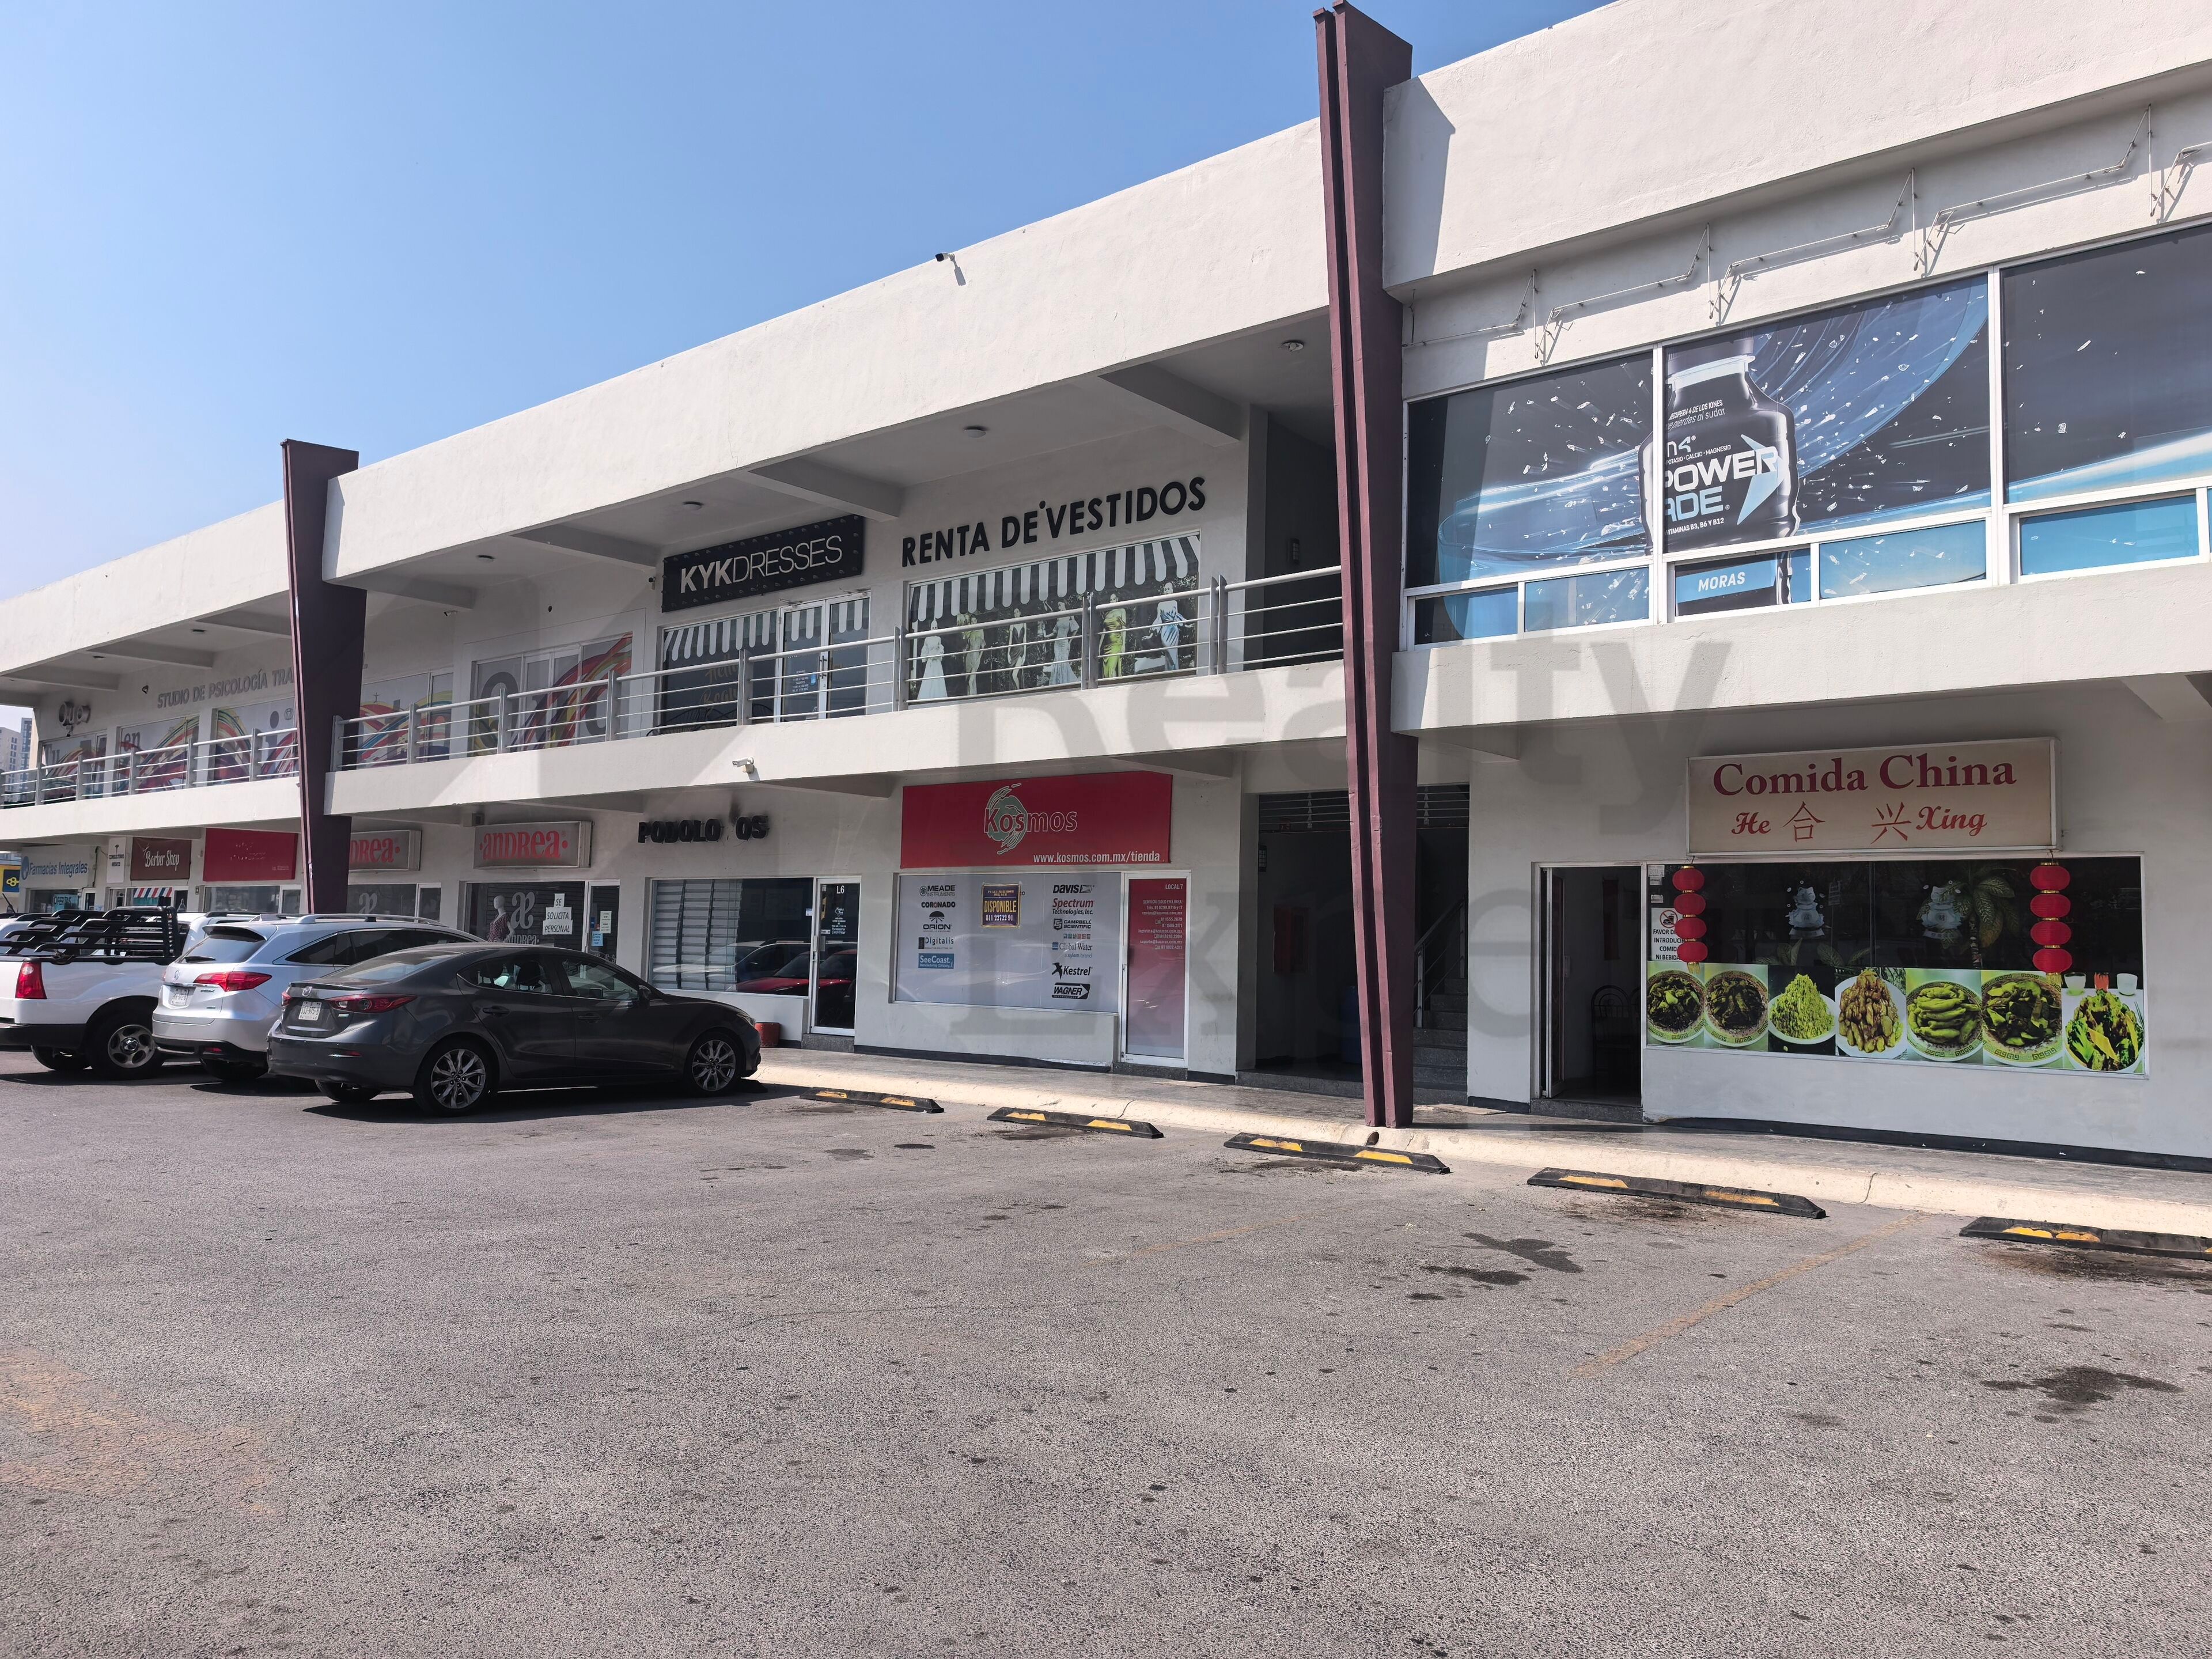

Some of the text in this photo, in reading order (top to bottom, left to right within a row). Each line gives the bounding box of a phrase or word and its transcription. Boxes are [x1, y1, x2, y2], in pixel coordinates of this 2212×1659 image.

[1692, 406, 1699, 414] DE
[1699, 403, 1708, 411] LOS
[1709, 400, 1723, 409] IONES
[1705, 408, 1725, 419] sudar
[1686, 452, 1703, 460] CALCIO
[1706, 444, 1731, 454] MAGNESIO
[1665, 446, 1779, 492] POWER
[902, 476, 1206, 567] RENTA DE VESTIDOS
[1713, 517, 1725, 525] B12
[680, 535, 843, 594] KYKDRESSES
[1698, 571, 1745, 592] MORAS
[157, 692, 190, 709] STUDIO
[193, 685, 206, 702] DE
[209, 668, 268, 699] PSICOLOGÍA
[1713, 752, 2017, 796] Comida China
[984, 808, 1077, 834] Kosmos
[1731, 811, 1771, 835] He
[1782, 801, 1826, 843] 合
[1870, 801, 1912, 845] 兴
[1915, 805, 1988, 837] Xing
[145, 850, 180, 872] Barber Shop
[1033, 850, 1160, 863] www.kosmos.com.mx/tienda
[29, 861, 88, 878] Farmacias Integrales
[836, 885, 845, 894] L6
[555, 898, 562, 906] SE
[984, 900, 1017, 912] DISPONIBLE
[1052, 898, 1094, 910] Spectrum
[547, 911, 569, 921] SOLICITA
[544, 925, 570, 933] PERSONAL
[925, 937, 954, 946] Digitalis
[1059, 942, 1076, 950] Global
[1063, 965, 1091, 976] Kestrel
[1054, 986, 1083, 995] WAGNER
